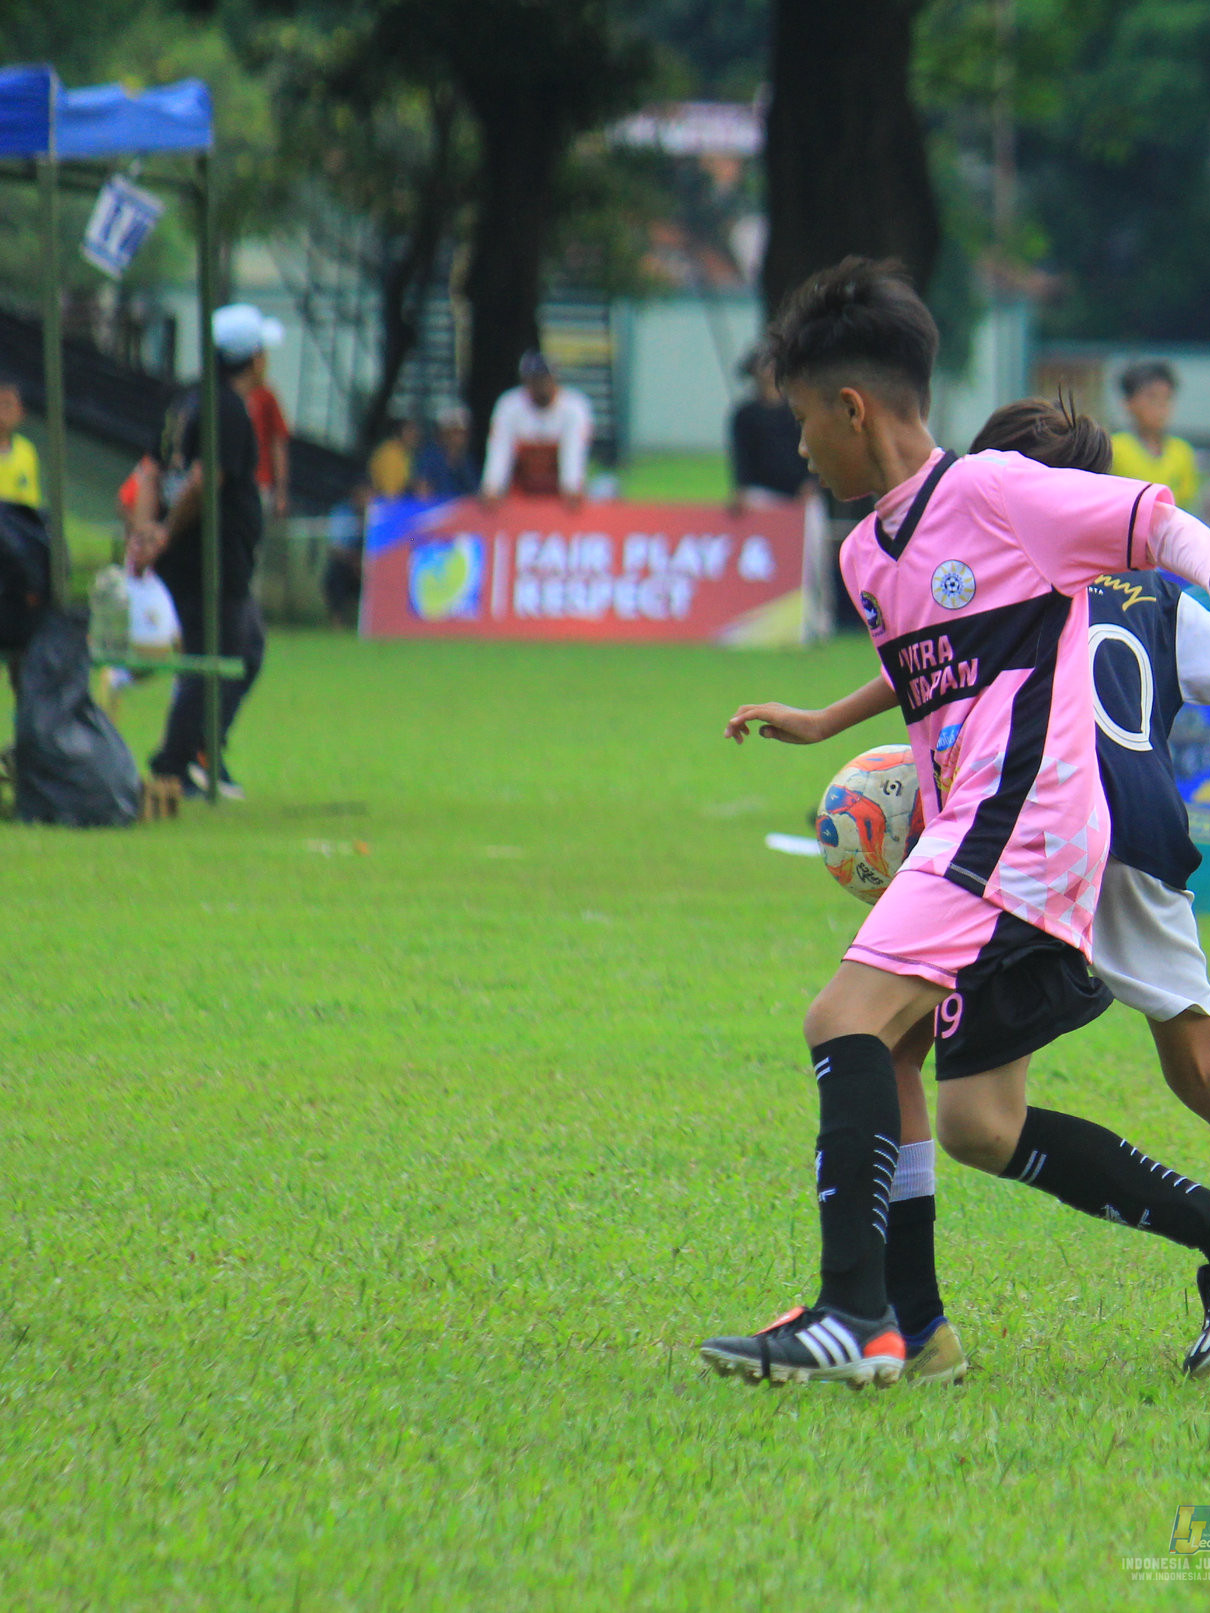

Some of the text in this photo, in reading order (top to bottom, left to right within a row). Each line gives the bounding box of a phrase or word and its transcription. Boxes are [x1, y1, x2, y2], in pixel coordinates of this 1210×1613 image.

[515, 531, 776, 582] FAIR PLAY &
[513, 576, 694, 620] RESPECT
